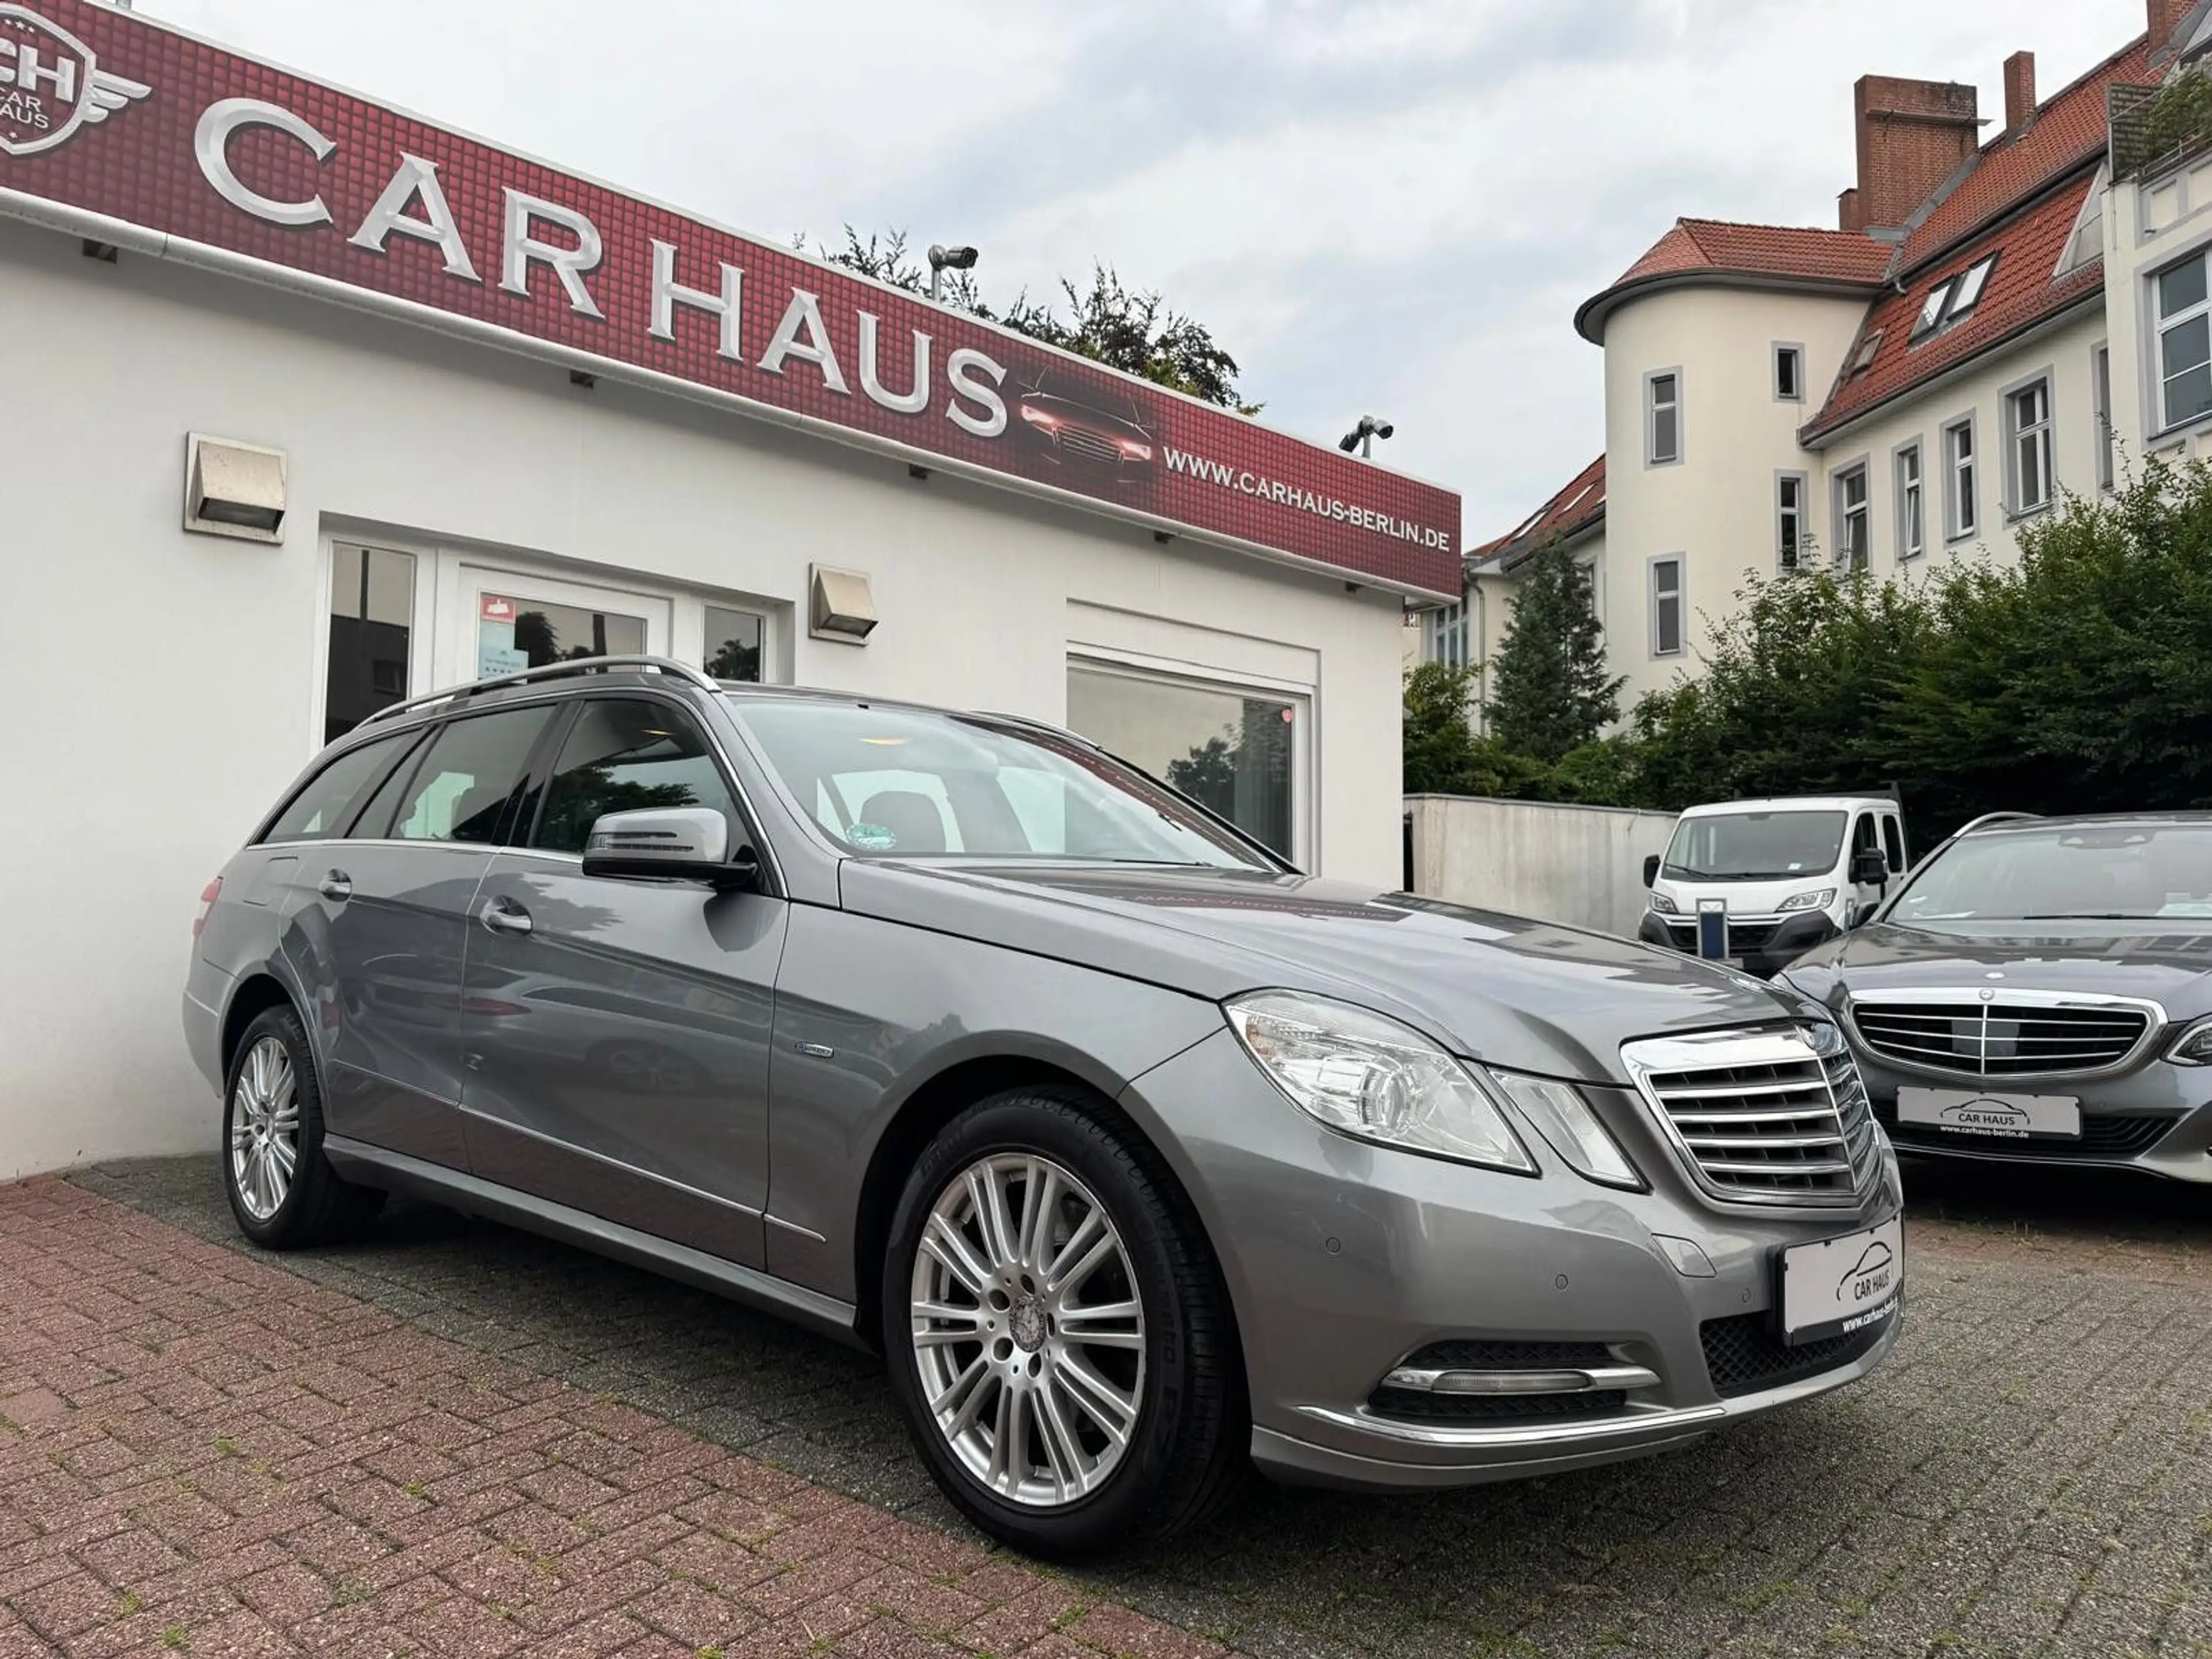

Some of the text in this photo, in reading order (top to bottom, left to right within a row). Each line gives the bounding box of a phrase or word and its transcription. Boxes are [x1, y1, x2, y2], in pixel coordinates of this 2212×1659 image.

[0, 103, 48, 129] AUS
[195, 97, 1007, 438] CAR HAUS
[1162, 445, 1450, 552] WWW.CARHAUS-BERLIN.DE
[1940, 1124, 2030, 1138] www.carhaus-berlin.de
[1958, 1113, 2016, 1126] CAR HAUS
[1854, 1269, 1889, 1301] CAR HAUS
